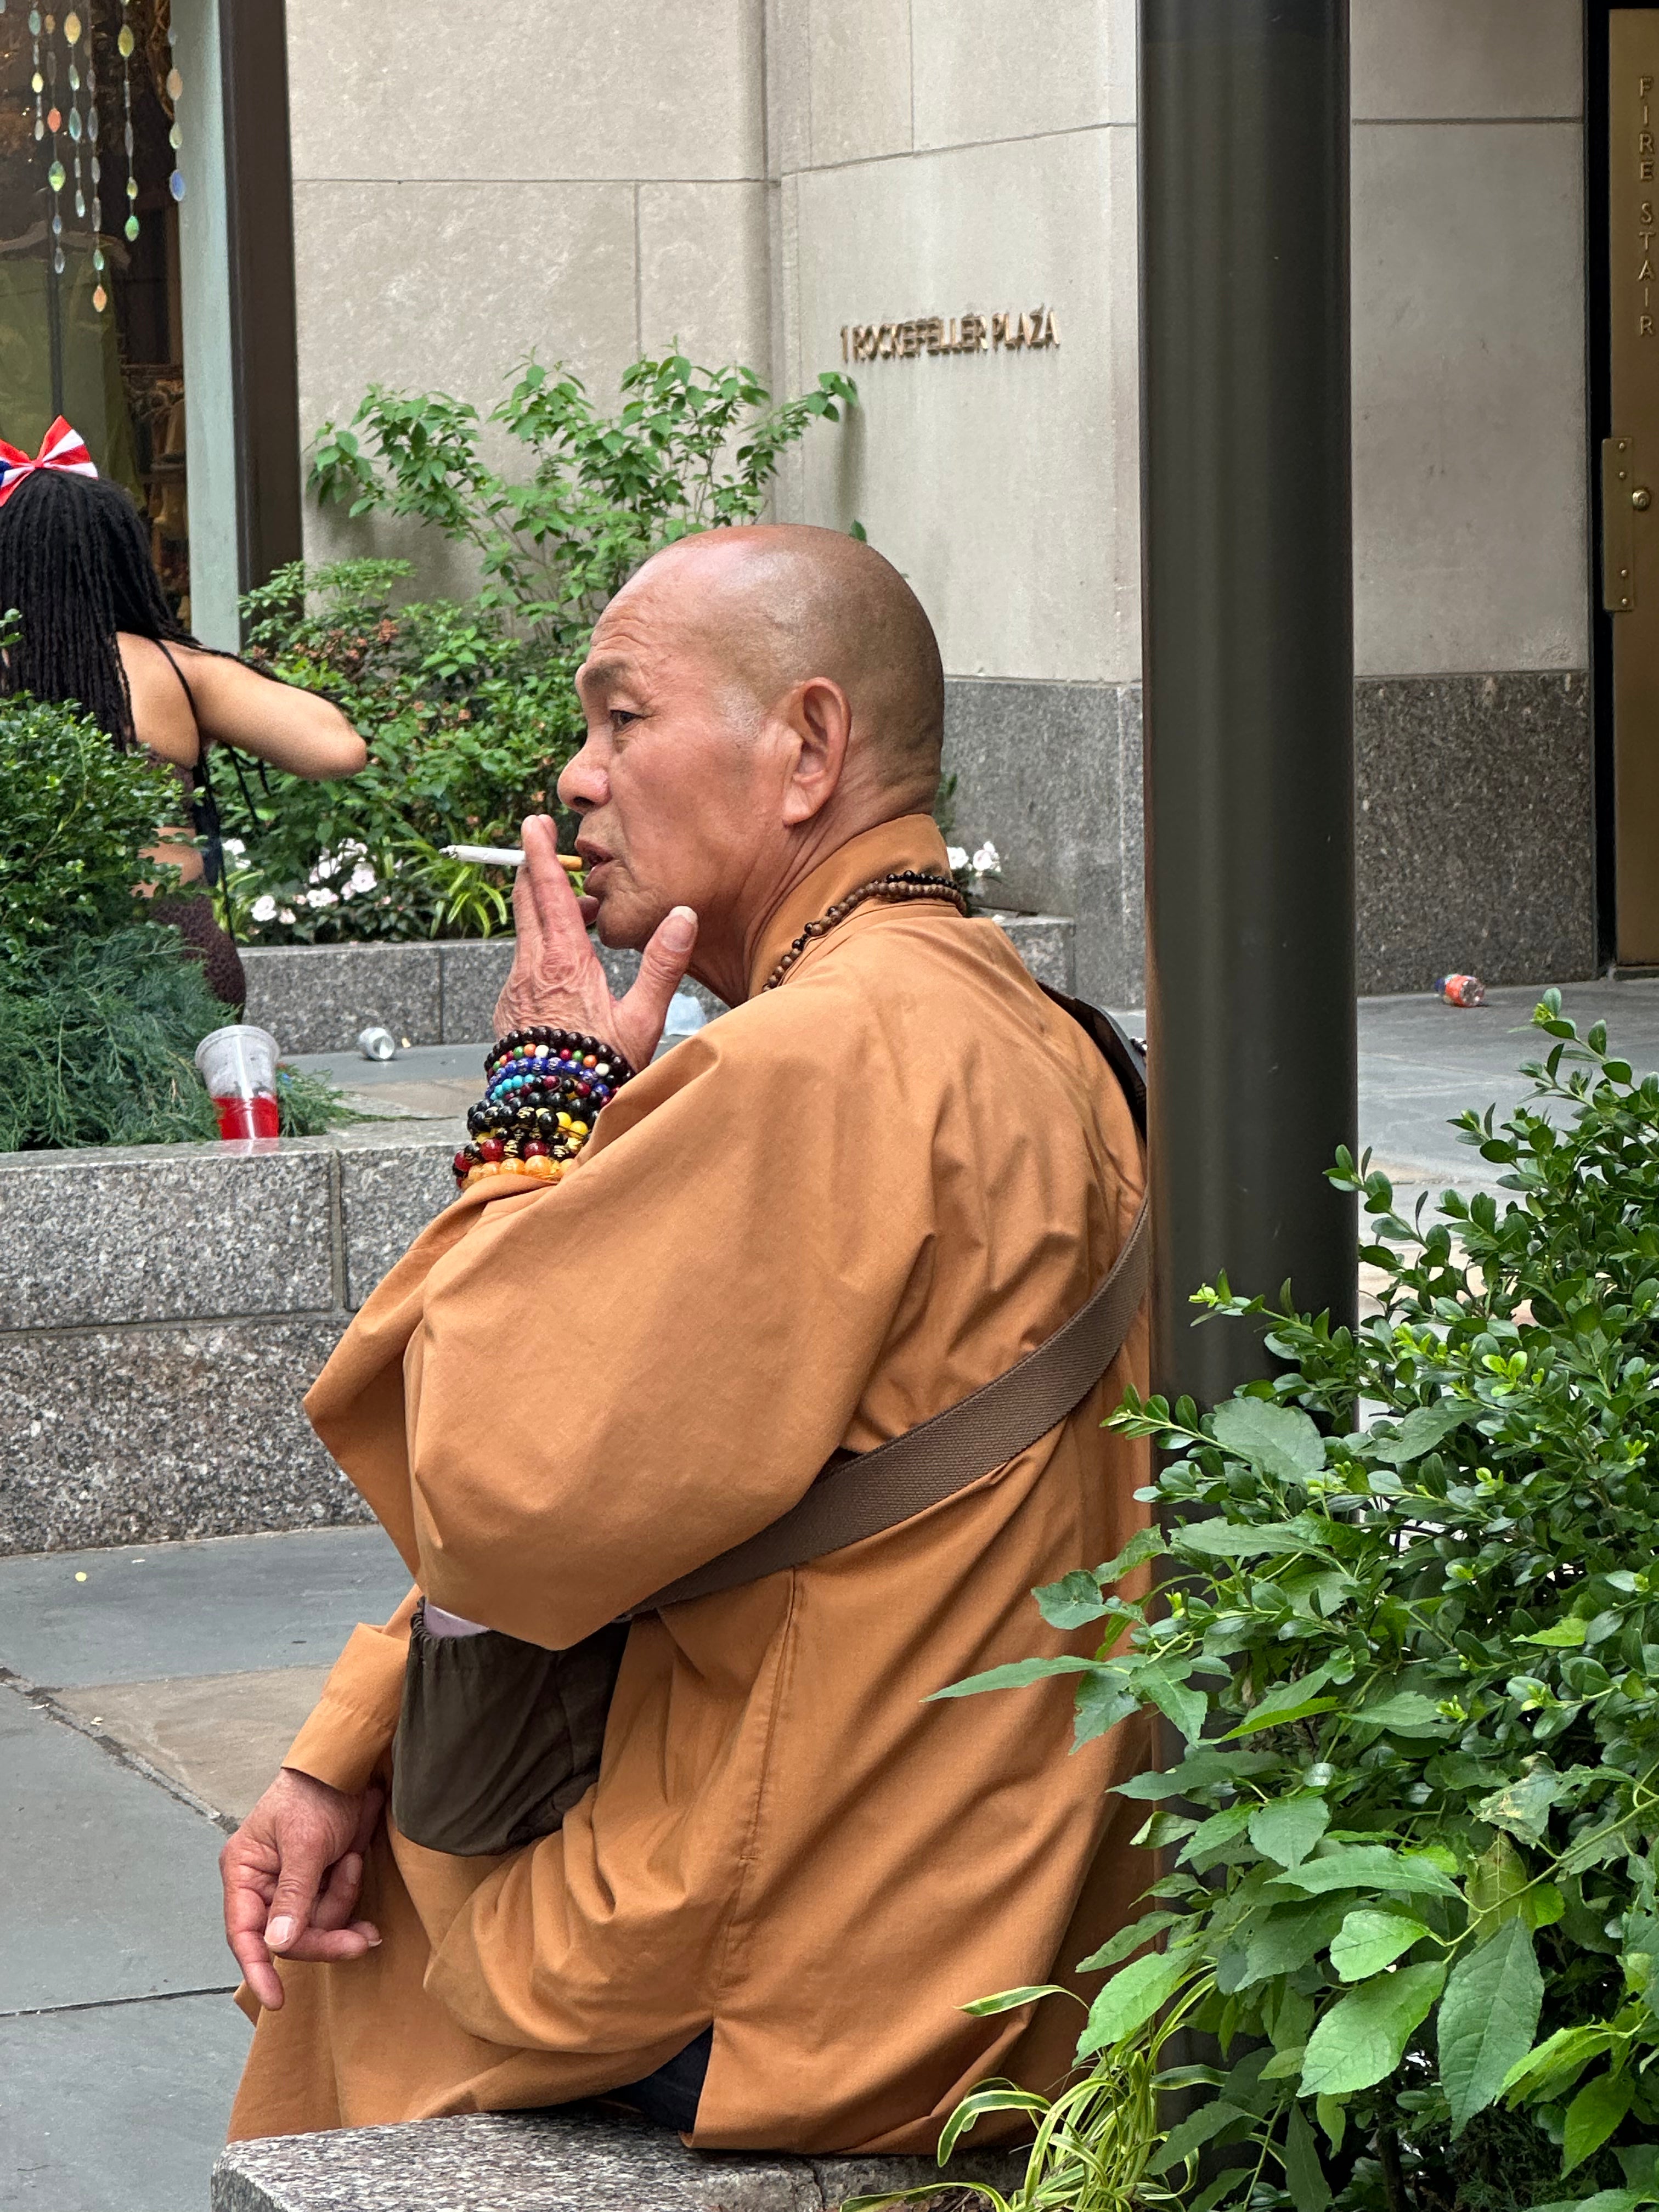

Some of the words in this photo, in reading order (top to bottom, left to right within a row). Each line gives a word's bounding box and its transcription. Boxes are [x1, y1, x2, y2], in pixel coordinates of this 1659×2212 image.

[1639, 76, 1654, 182] FIRE
[1638, 202, 1656, 336] STAIR
[852, 314, 988, 360] ROCKEFELLER
[992, 304, 1060, 352] PLAZA
